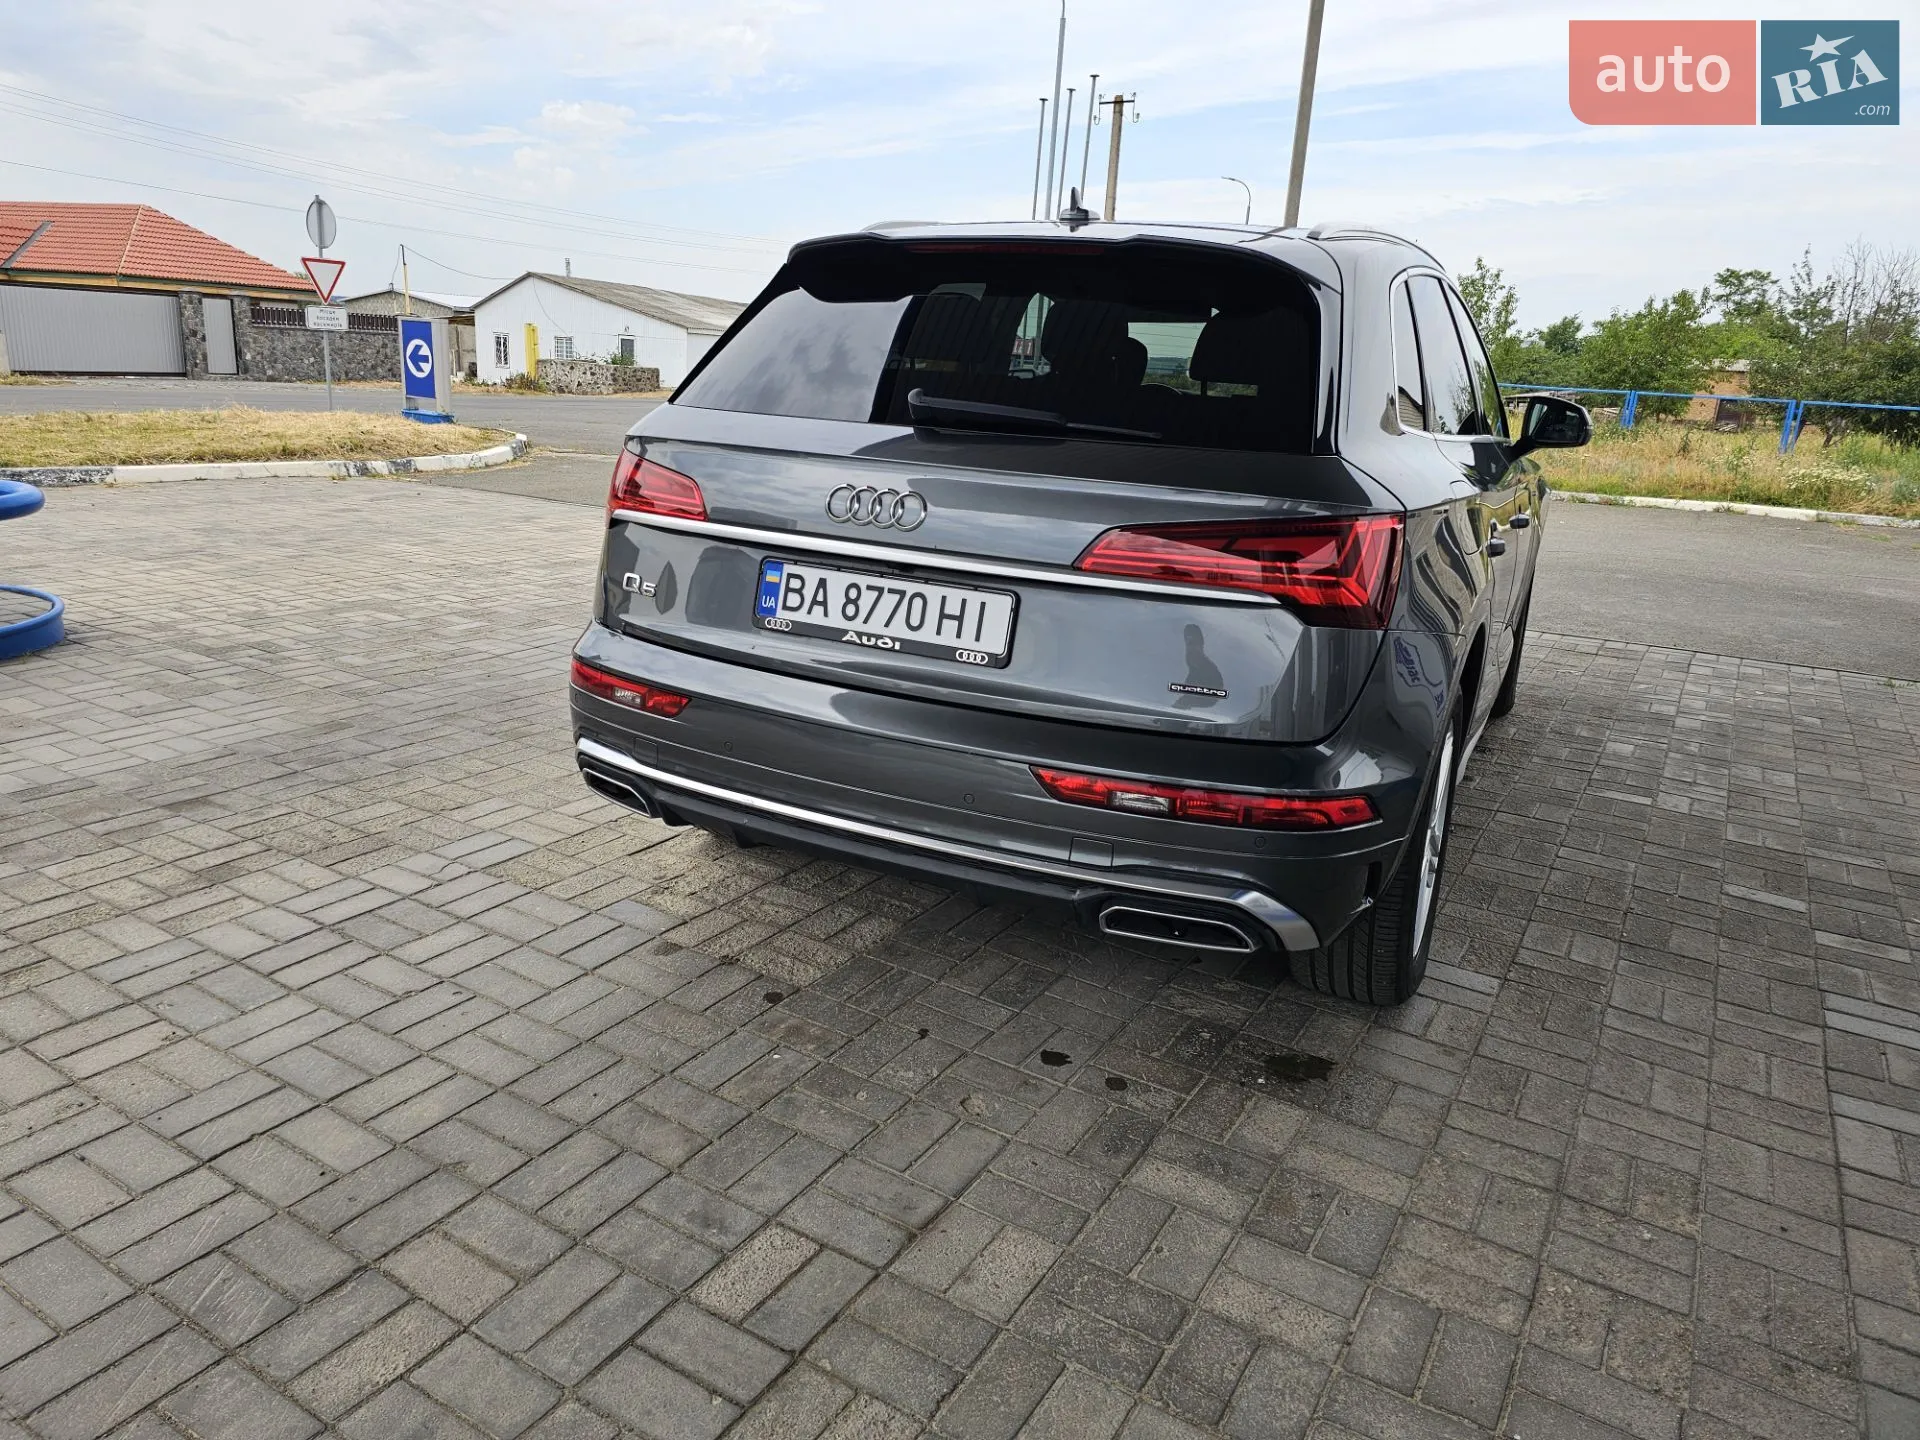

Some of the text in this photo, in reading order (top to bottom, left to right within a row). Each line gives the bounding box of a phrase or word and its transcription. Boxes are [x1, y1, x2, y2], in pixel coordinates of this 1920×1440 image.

[622, 572, 657, 598] Q5
[761, 595, 776, 609] UA
[781, 572, 986, 642] BA 8770 HI
[841, 630, 900, 650] Audi
[1170, 684, 1227, 697] quattro
